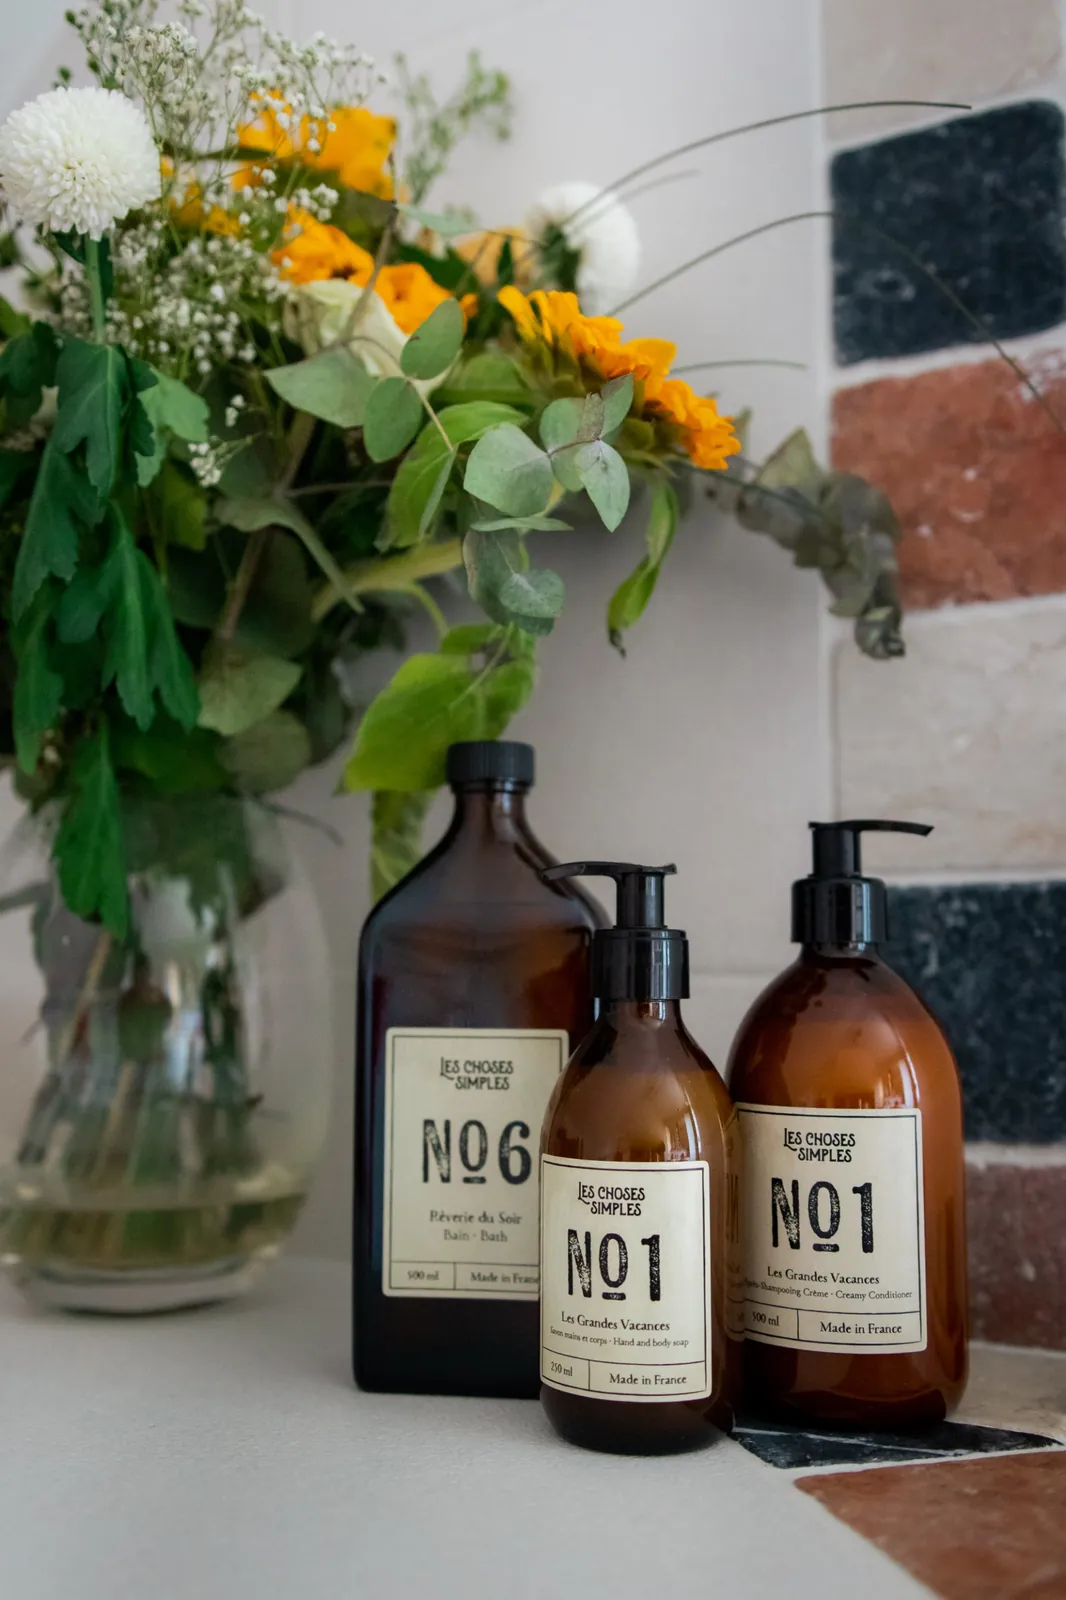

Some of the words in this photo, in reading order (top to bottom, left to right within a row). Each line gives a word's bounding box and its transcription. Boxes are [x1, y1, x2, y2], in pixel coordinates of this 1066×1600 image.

[463, 1060, 514, 1074] CHOSES
[455, 1076, 510, 1090] SIMPLES
[805, 1132, 856, 1147] CHOSES
[798, 1148, 852, 1163] SIMPLES
[598, 1186, 646, 1201] CHOSES
[590, 1201, 642, 1216] SIMPLES
[478, 1210, 494, 1224] du
[498, 1211, 522, 1225] Soir
[443, 1229, 470, 1241] Bain
[480, 1229, 508, 1243] Bath
[426, 1270, 440, 1281] ml
[470, 1271, 498, 1282] Made
[501, 1272, 512, 1284] in
[767, 1265, 783, 1279] Les
[785, 1268, 828, 1284] Grandes
[830, 1272, 880, 1285] Vacances
[803, 1288, 829, 1298] Crème
[835, 1290, 867, 1301] Creamy
[868, 1290, 913, 1300] Conditioner
[561, 1311, 575, 1324] Les
[577, 1314, 618, 1330] Grandes
[620, 1319, 671, 1331] Vacances
[752, 1311, 767, 1323] 500
[768, 1315, 780, 1327] ml
[820, 1321, 852, 1334] Made
[855, 1323, 866, 1334] in
[868, 1323, 903, 1334] France
[564, 1331, 581, 1341] mains
[589, 1337, 608, 1347] corps
[613, 1337, 635, 1347] Hand
[636, 1338, 651, 1347] and
[652, 1338, 671, 1349] body
[672, 1339, 690, 1349] soap
[550, 1361, 563, 1374] 250
[563, 1365, 573, 1377] ml
[609, 1373, 639, 1385] Made
[641, 1375, 652, 1385] in
[654, 1374, 687, 1385] France
